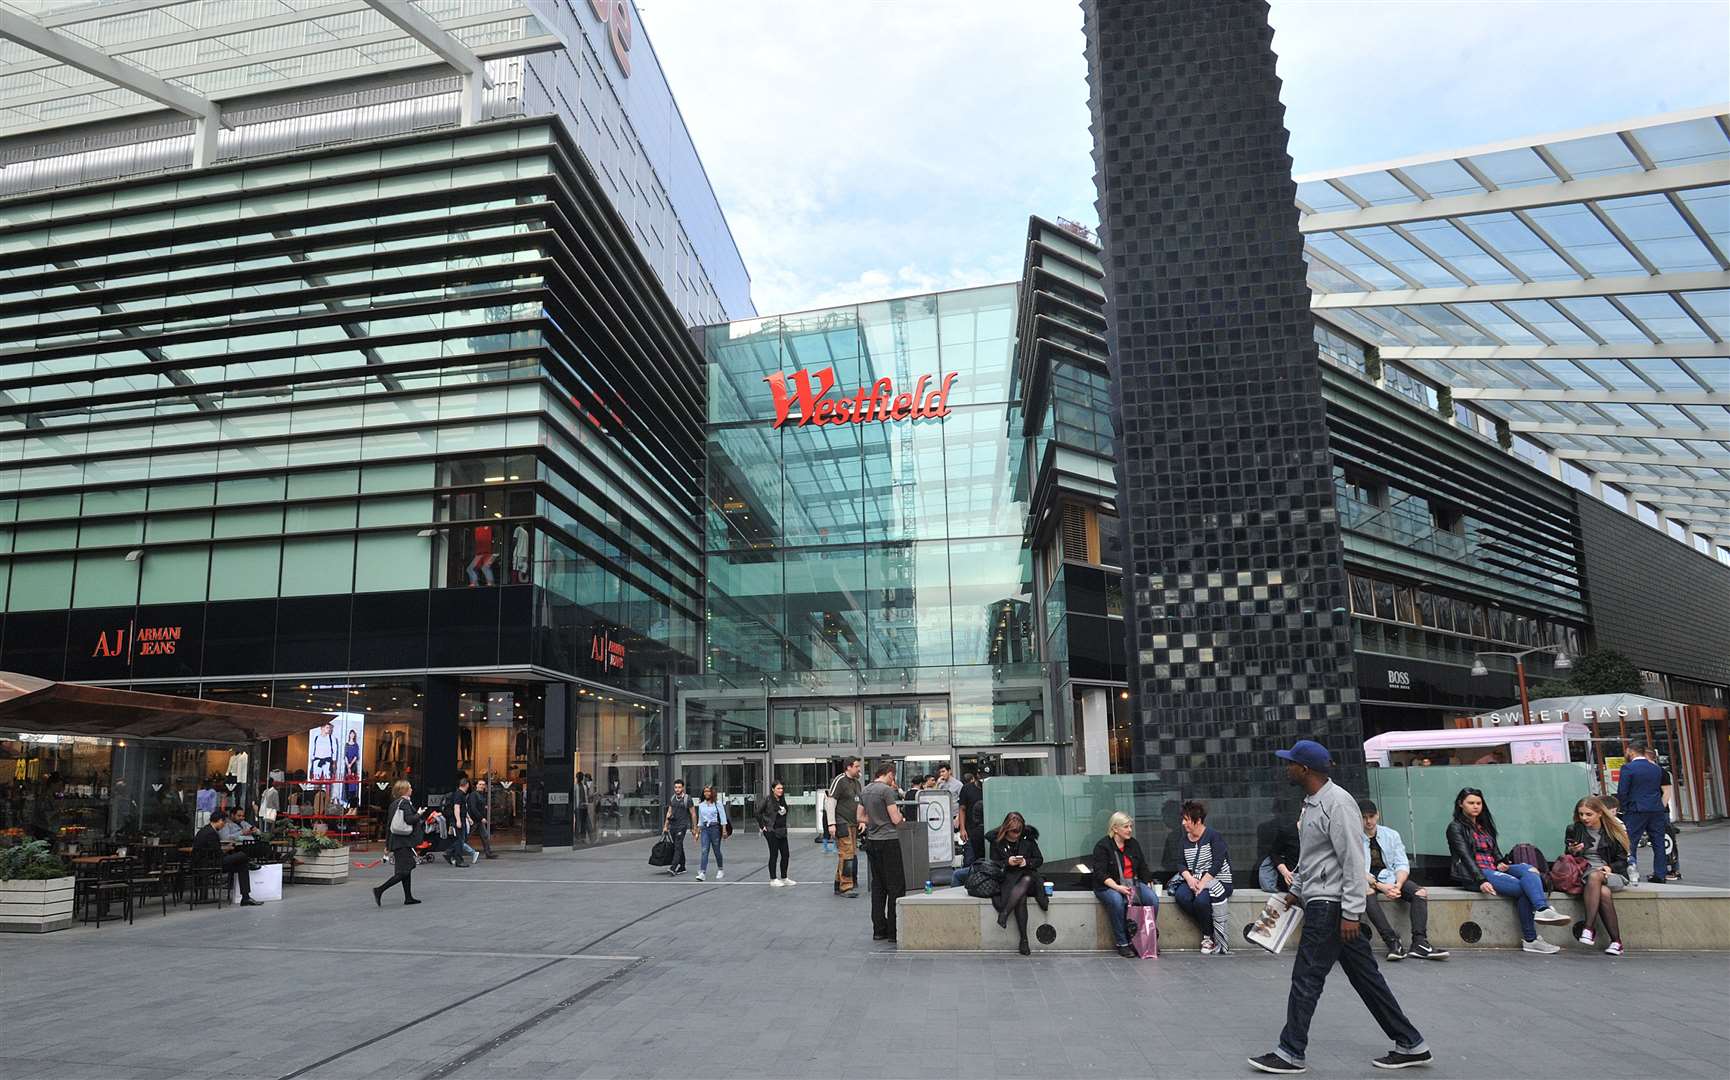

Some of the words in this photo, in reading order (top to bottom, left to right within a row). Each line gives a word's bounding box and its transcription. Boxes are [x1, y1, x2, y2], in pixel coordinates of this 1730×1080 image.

[763, 367, 958, 430] Westfield
[137, 627, 182, 641] ARMANI
[92, 630, 124, 657] AJ
[140, 641, 176, 656] JEANS
[591, 634, 604, 661] AJ
[1387, 670, 1410, 685] BOSS
[1583, 704, 1647, 719] EAST
